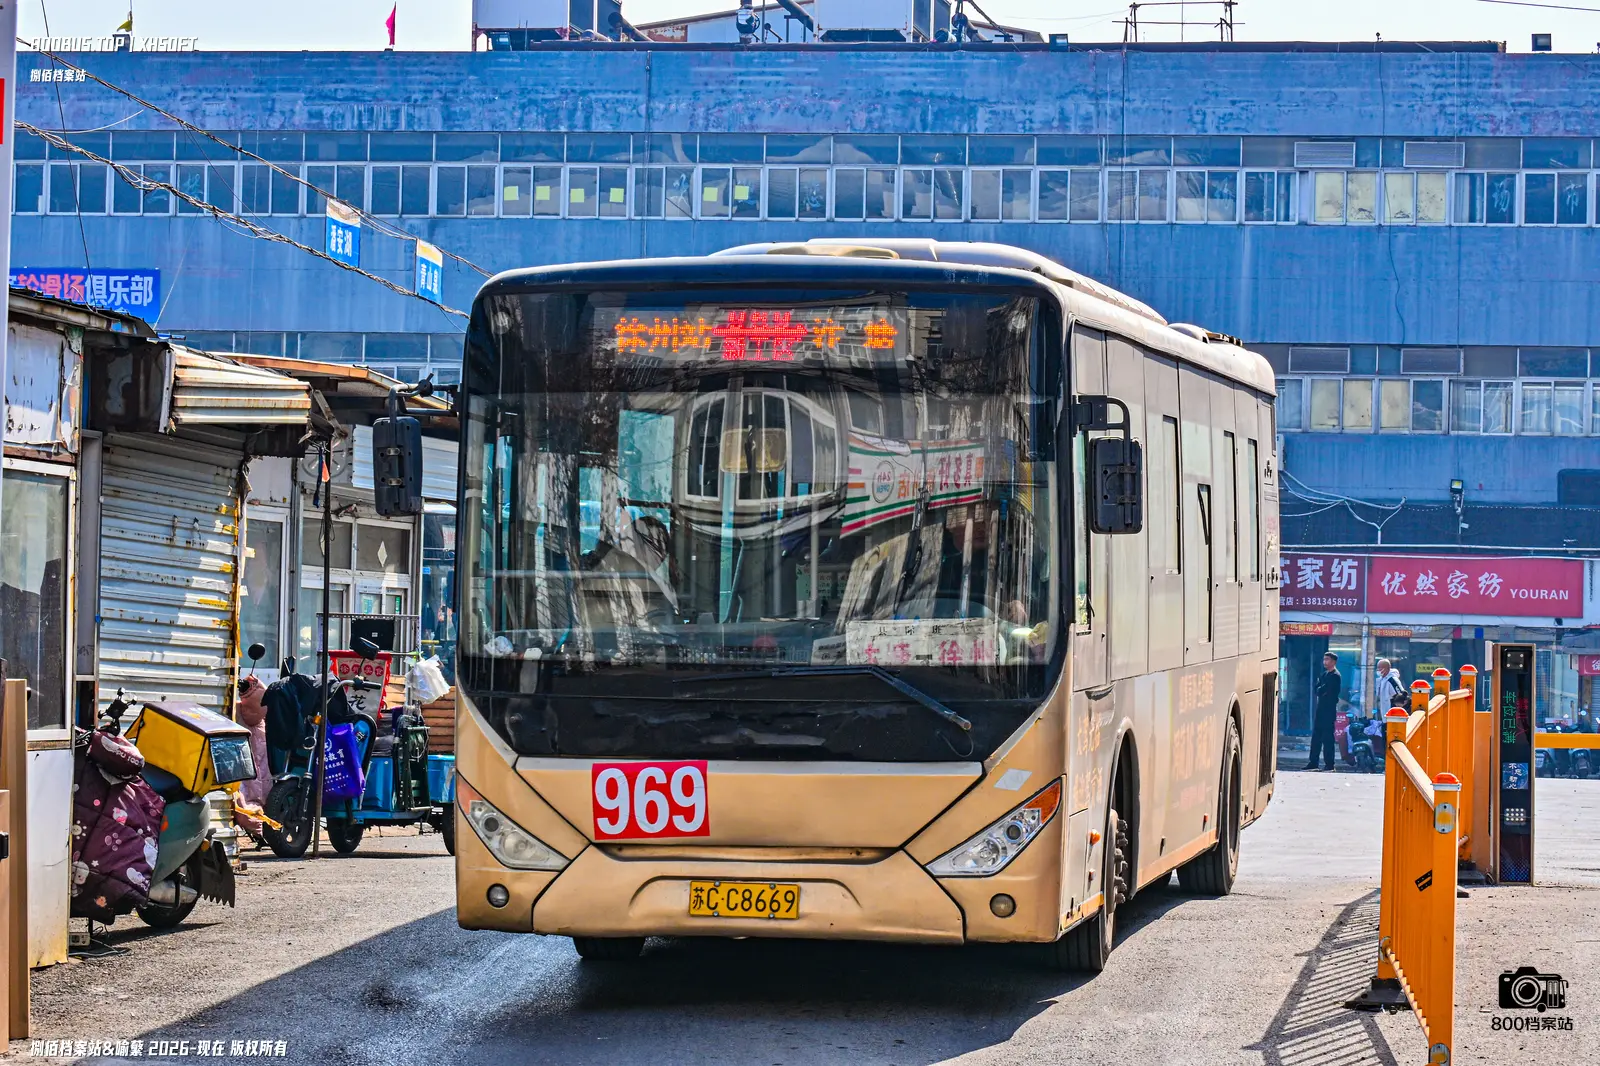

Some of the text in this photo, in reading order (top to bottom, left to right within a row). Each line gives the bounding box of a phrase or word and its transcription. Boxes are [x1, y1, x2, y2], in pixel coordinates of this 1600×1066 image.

[9, 274, 153, 306] 轮滑场俱乐部
[1381, 569, 1569, 600] 优然家纺 YOURAN
[1502, 690, 1517, 744] 车位已满
[594, 766, 706, 835] 969
[692, 886, 796, 913] 苏C·C8669
